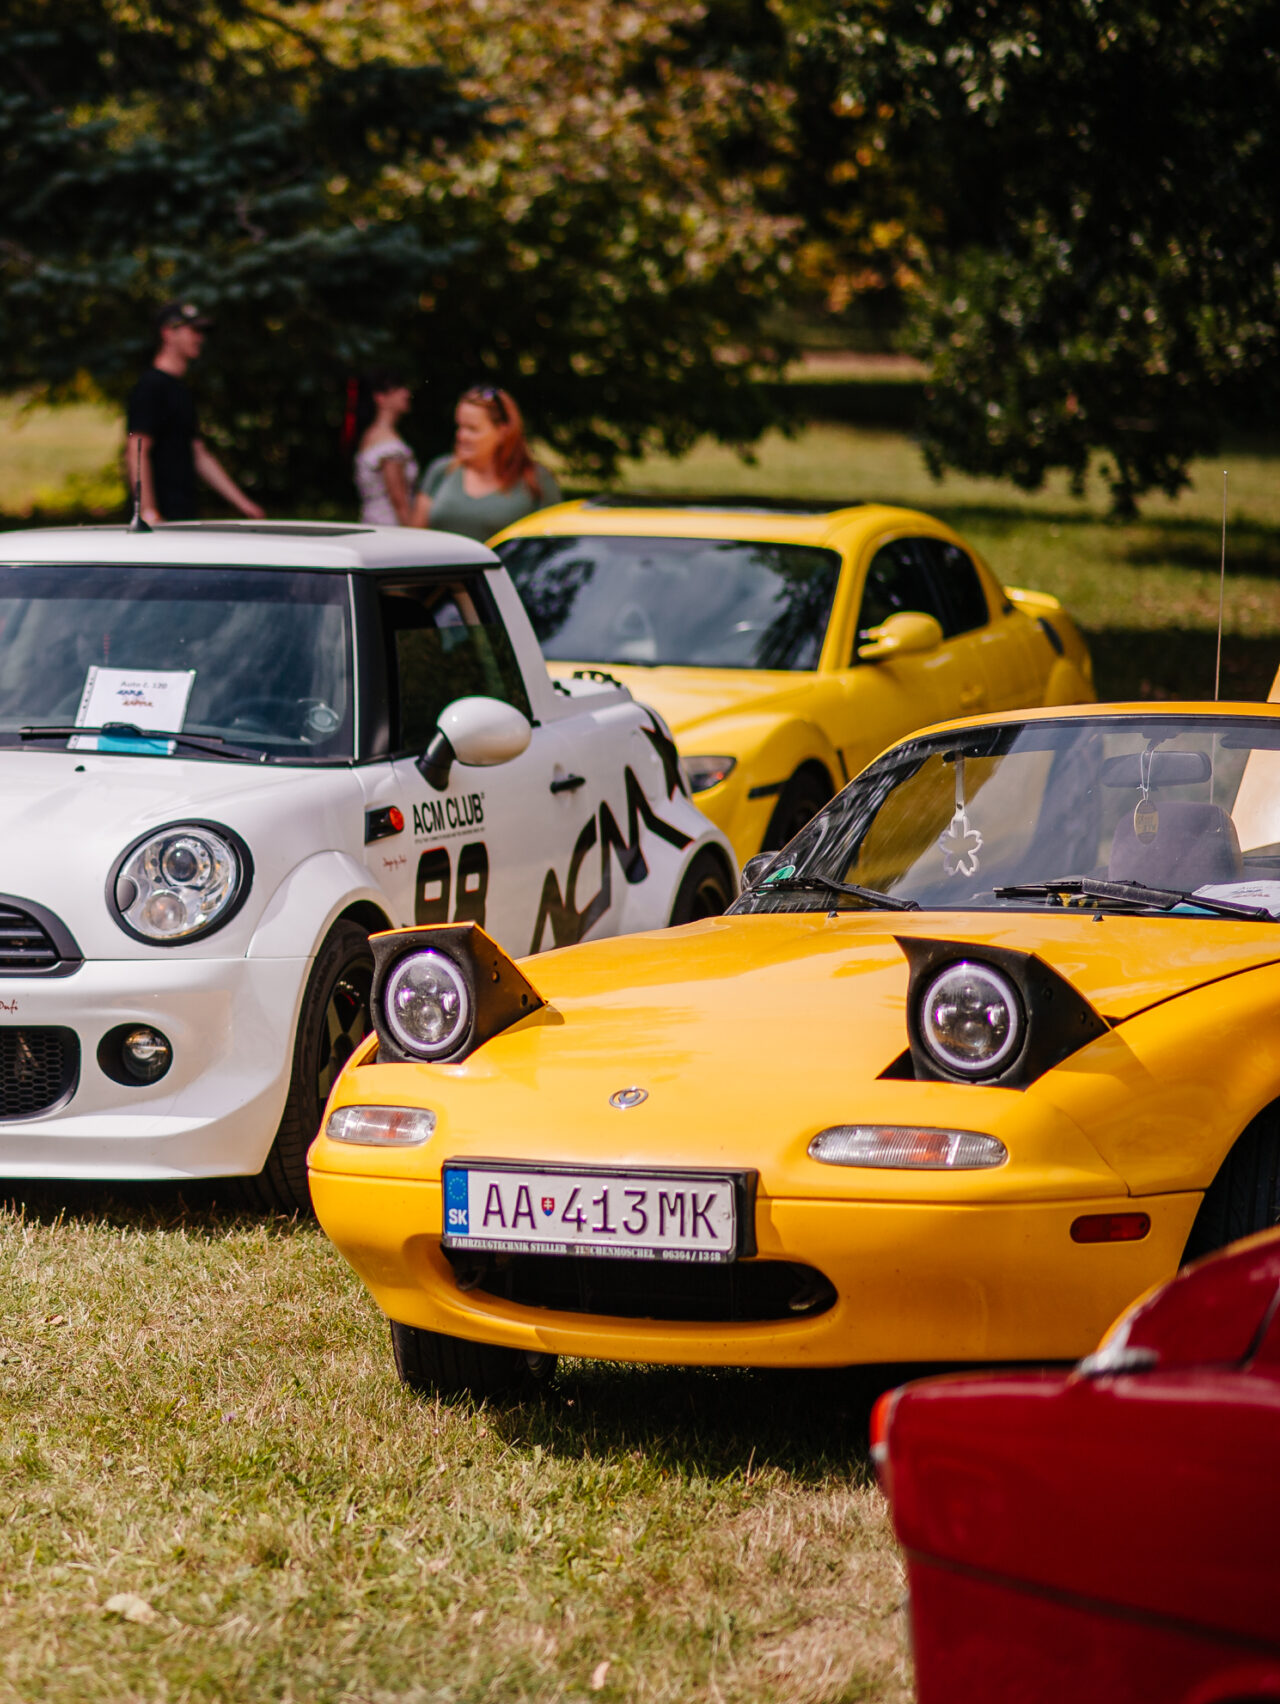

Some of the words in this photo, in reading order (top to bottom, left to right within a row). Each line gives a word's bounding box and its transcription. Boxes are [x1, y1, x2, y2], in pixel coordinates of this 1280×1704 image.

[412, 799, 446, 835] ACM
[448, 1208, 468, 1226] SK
[482, 1181, 537, 1230] AA
[561, 1184, 719, 1239] 413MK
[530, 1242, 567, 1254] STELLER
